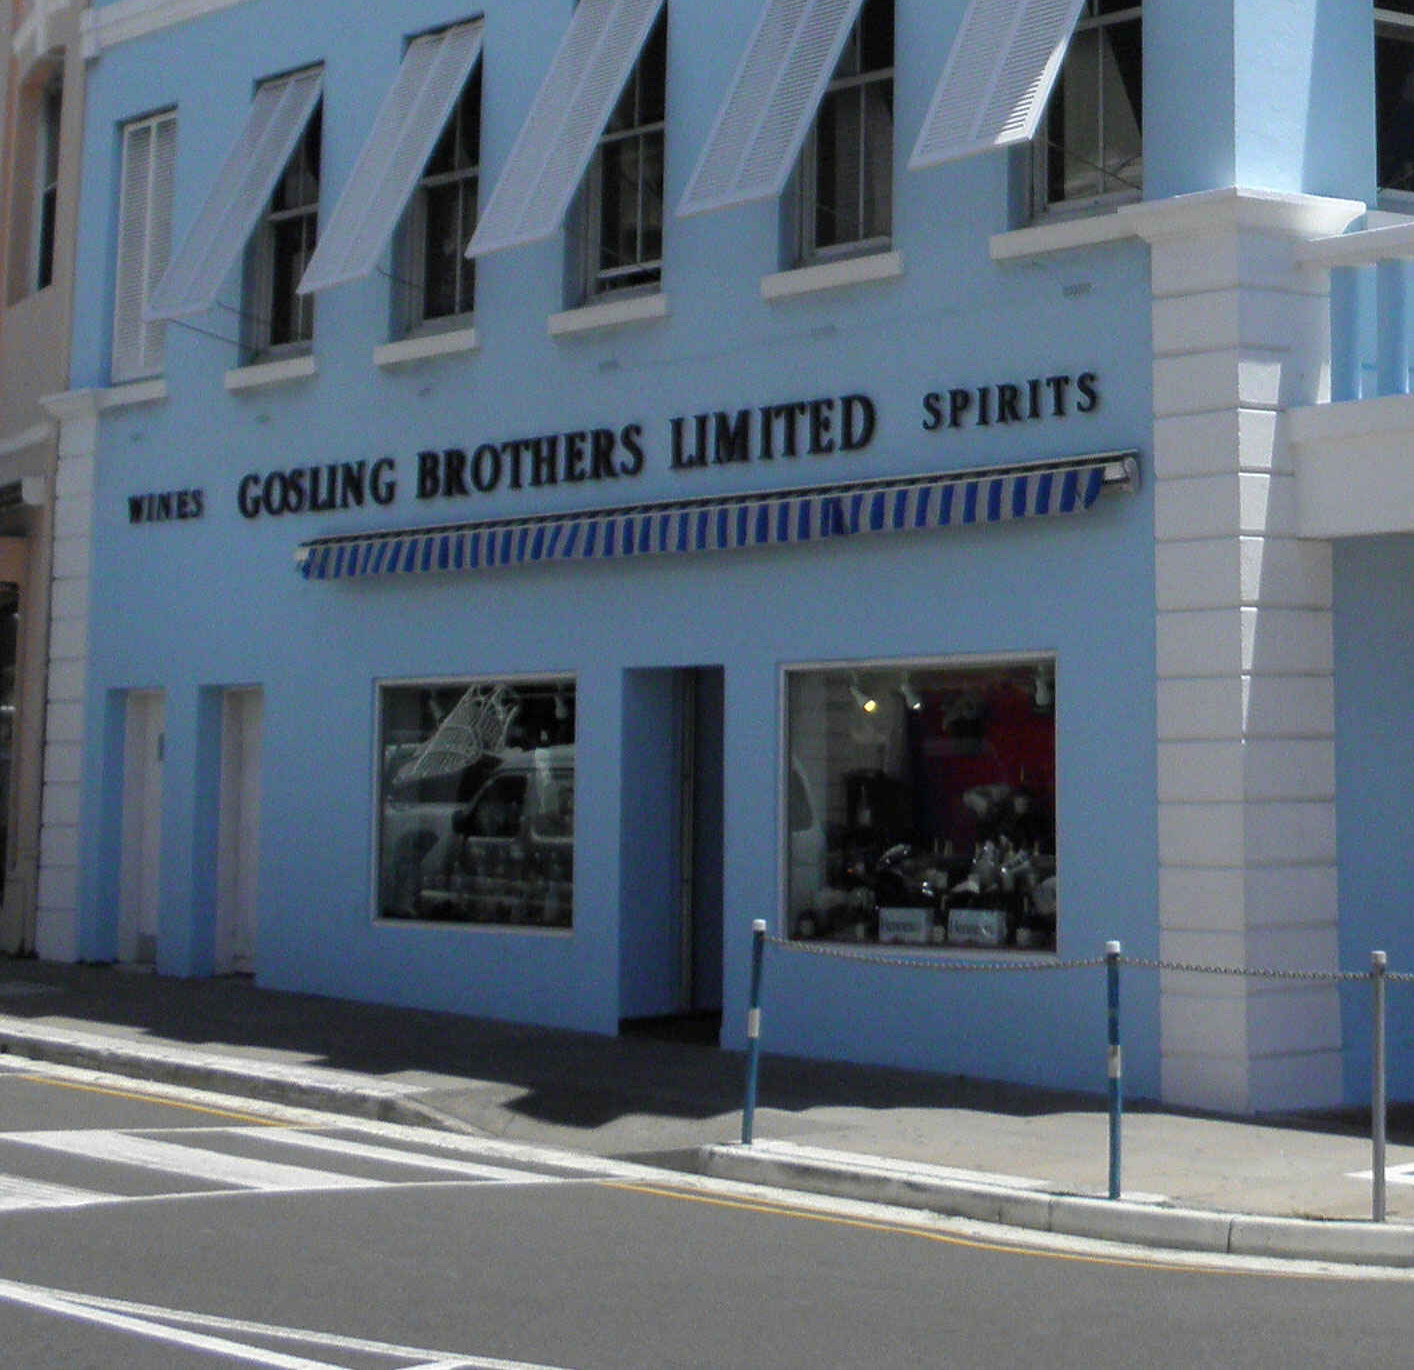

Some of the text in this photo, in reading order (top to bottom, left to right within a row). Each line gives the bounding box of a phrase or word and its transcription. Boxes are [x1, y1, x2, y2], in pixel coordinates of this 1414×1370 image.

[128, 371, 1098, 524] WINES GOSLING BROTHERS LIMITED SPIRITS
